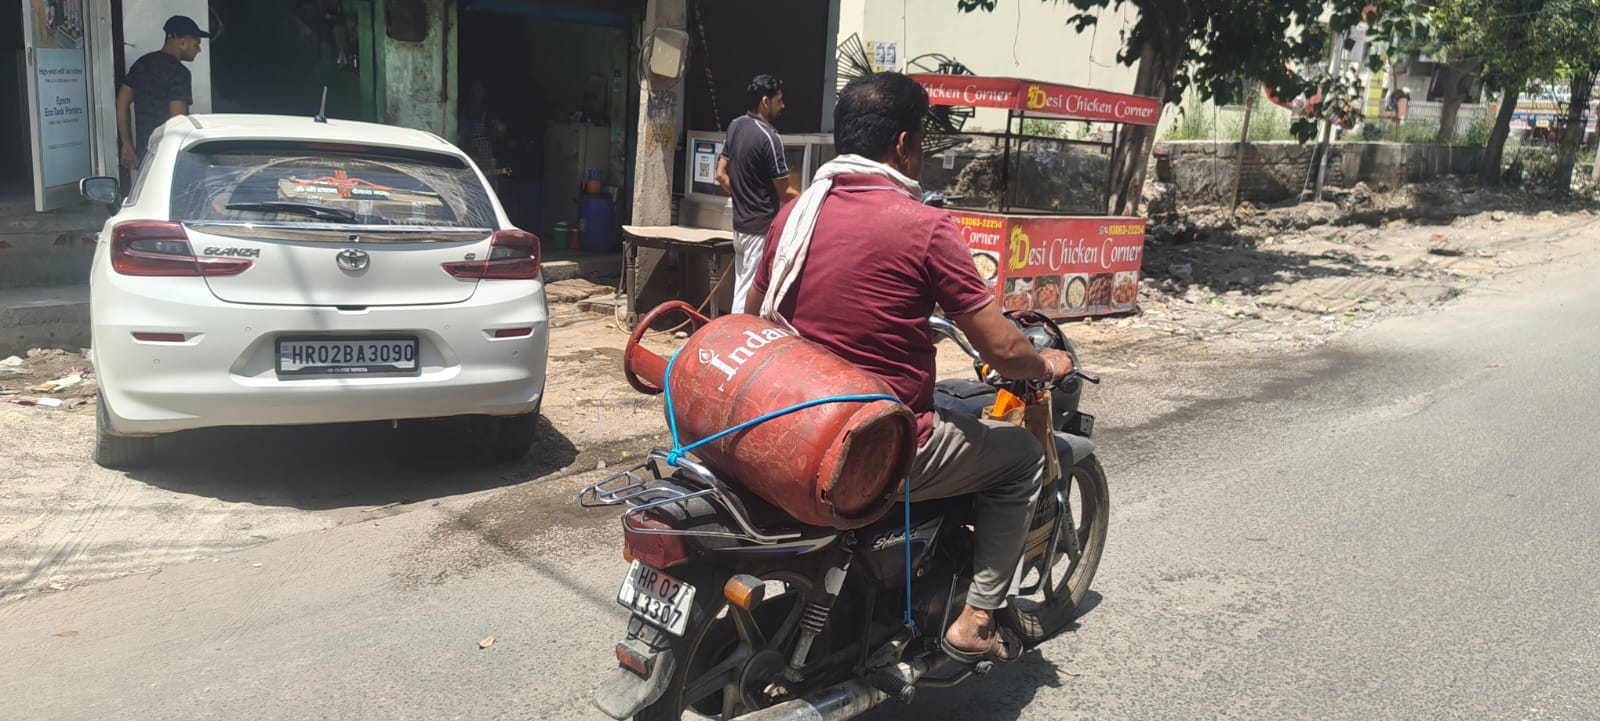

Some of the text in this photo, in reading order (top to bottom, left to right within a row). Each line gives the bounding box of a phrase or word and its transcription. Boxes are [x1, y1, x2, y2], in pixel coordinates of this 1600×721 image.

[963, 85, 1011, 103] Corner
[1028, 84, 1152, 118] Desi Chicken Corner
[962, 226, 1000, 246] Corner
[204, 247, 260, 259] GLANZA
[1010, 227, 1141, 272] Desi Chicken Corner
[292, 344, 414, 364] HR02BA3090
[638, 567, 680, 605] HR 02
[641, 596, 682, 628] 3307
